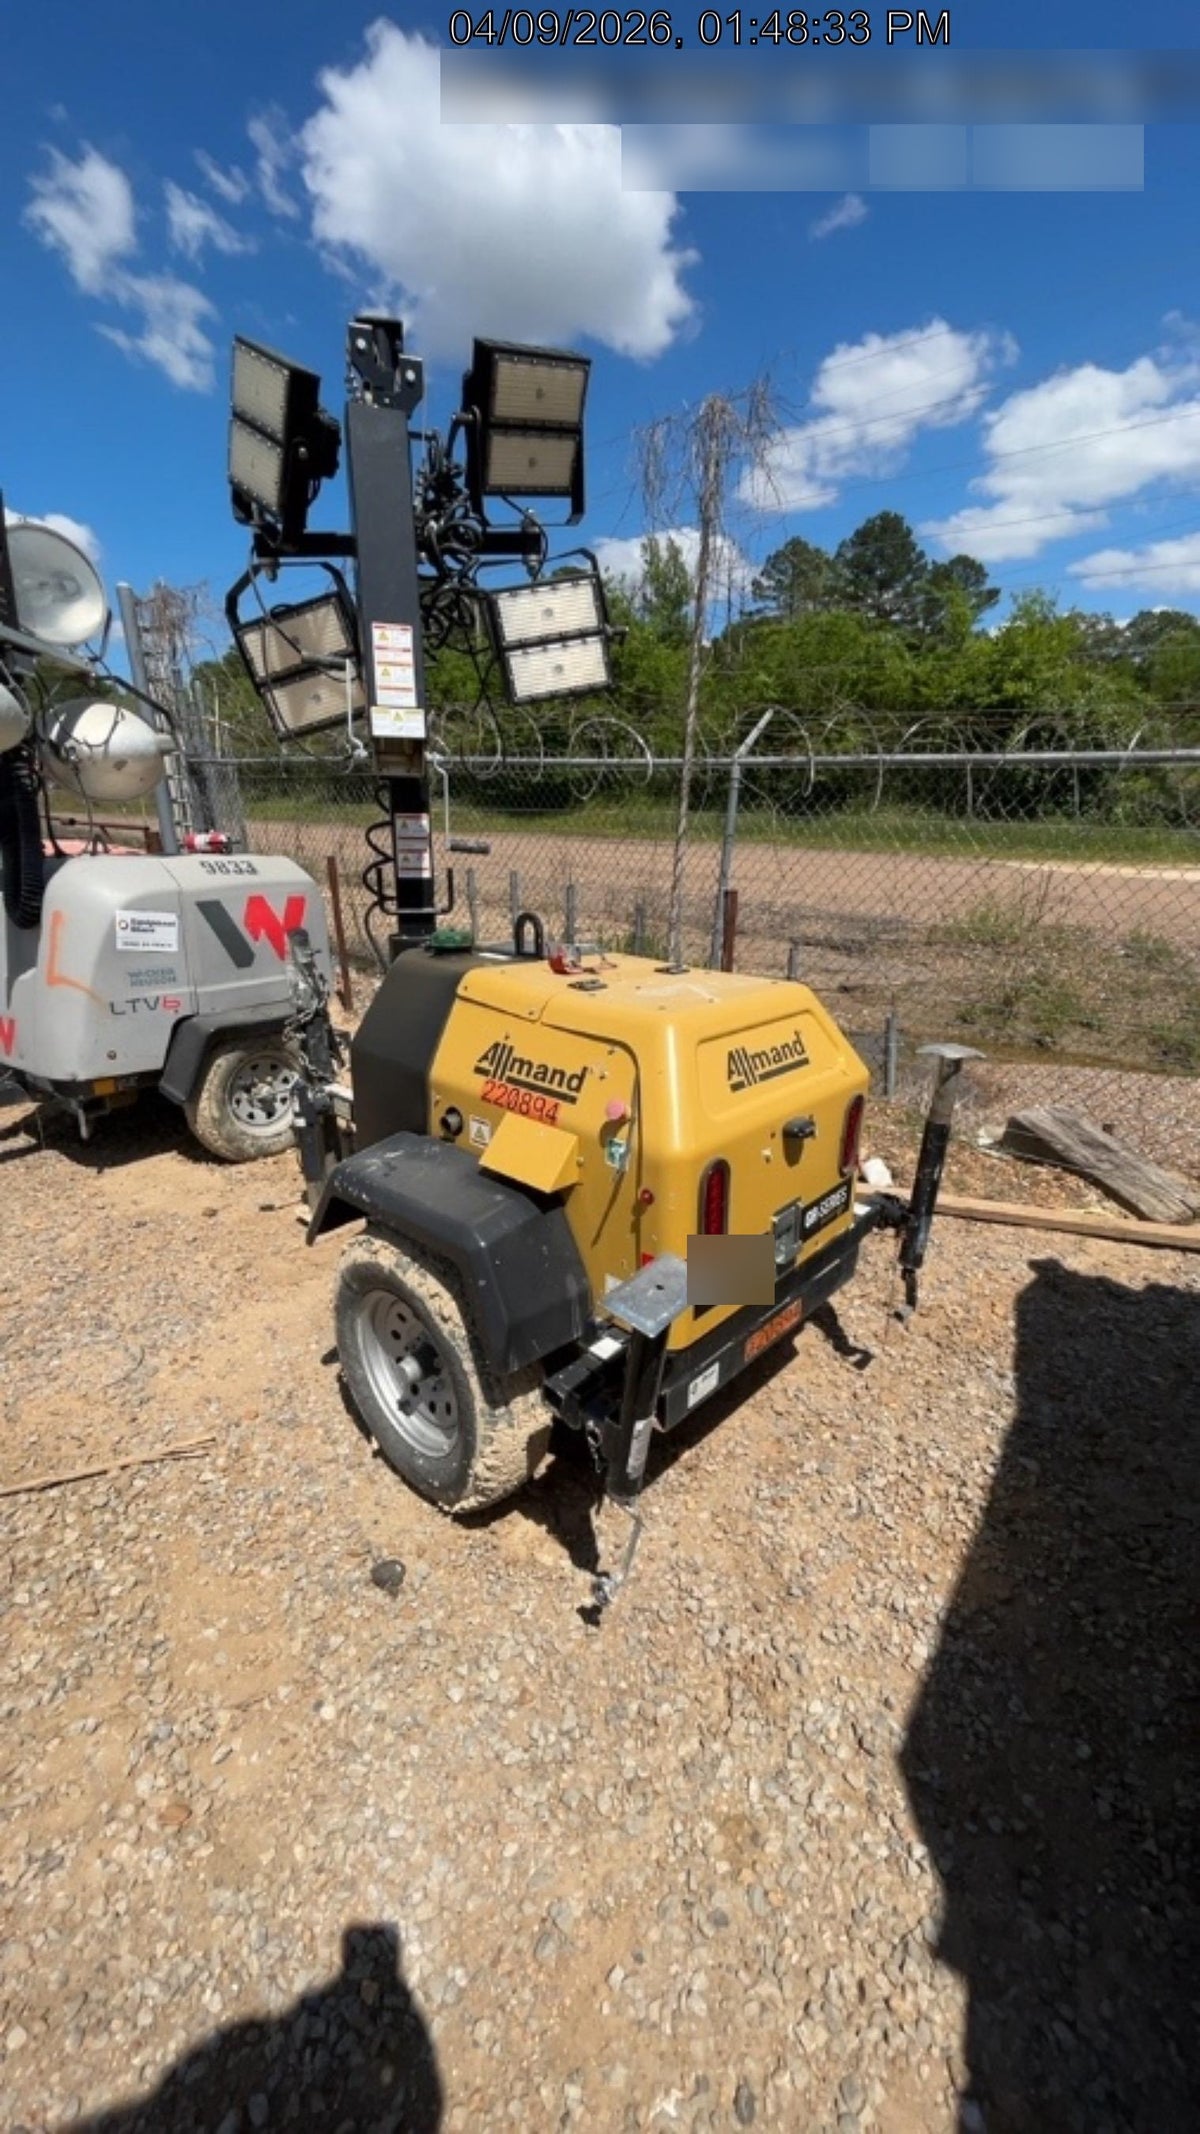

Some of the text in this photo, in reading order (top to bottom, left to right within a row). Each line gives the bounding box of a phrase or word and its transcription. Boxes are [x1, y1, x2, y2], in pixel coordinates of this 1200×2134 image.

[475, 1041, 588, 1095] Allmand
[727, 1030, 805, 1088] Allmand
[481, 1079, 560, 1125] 220894
